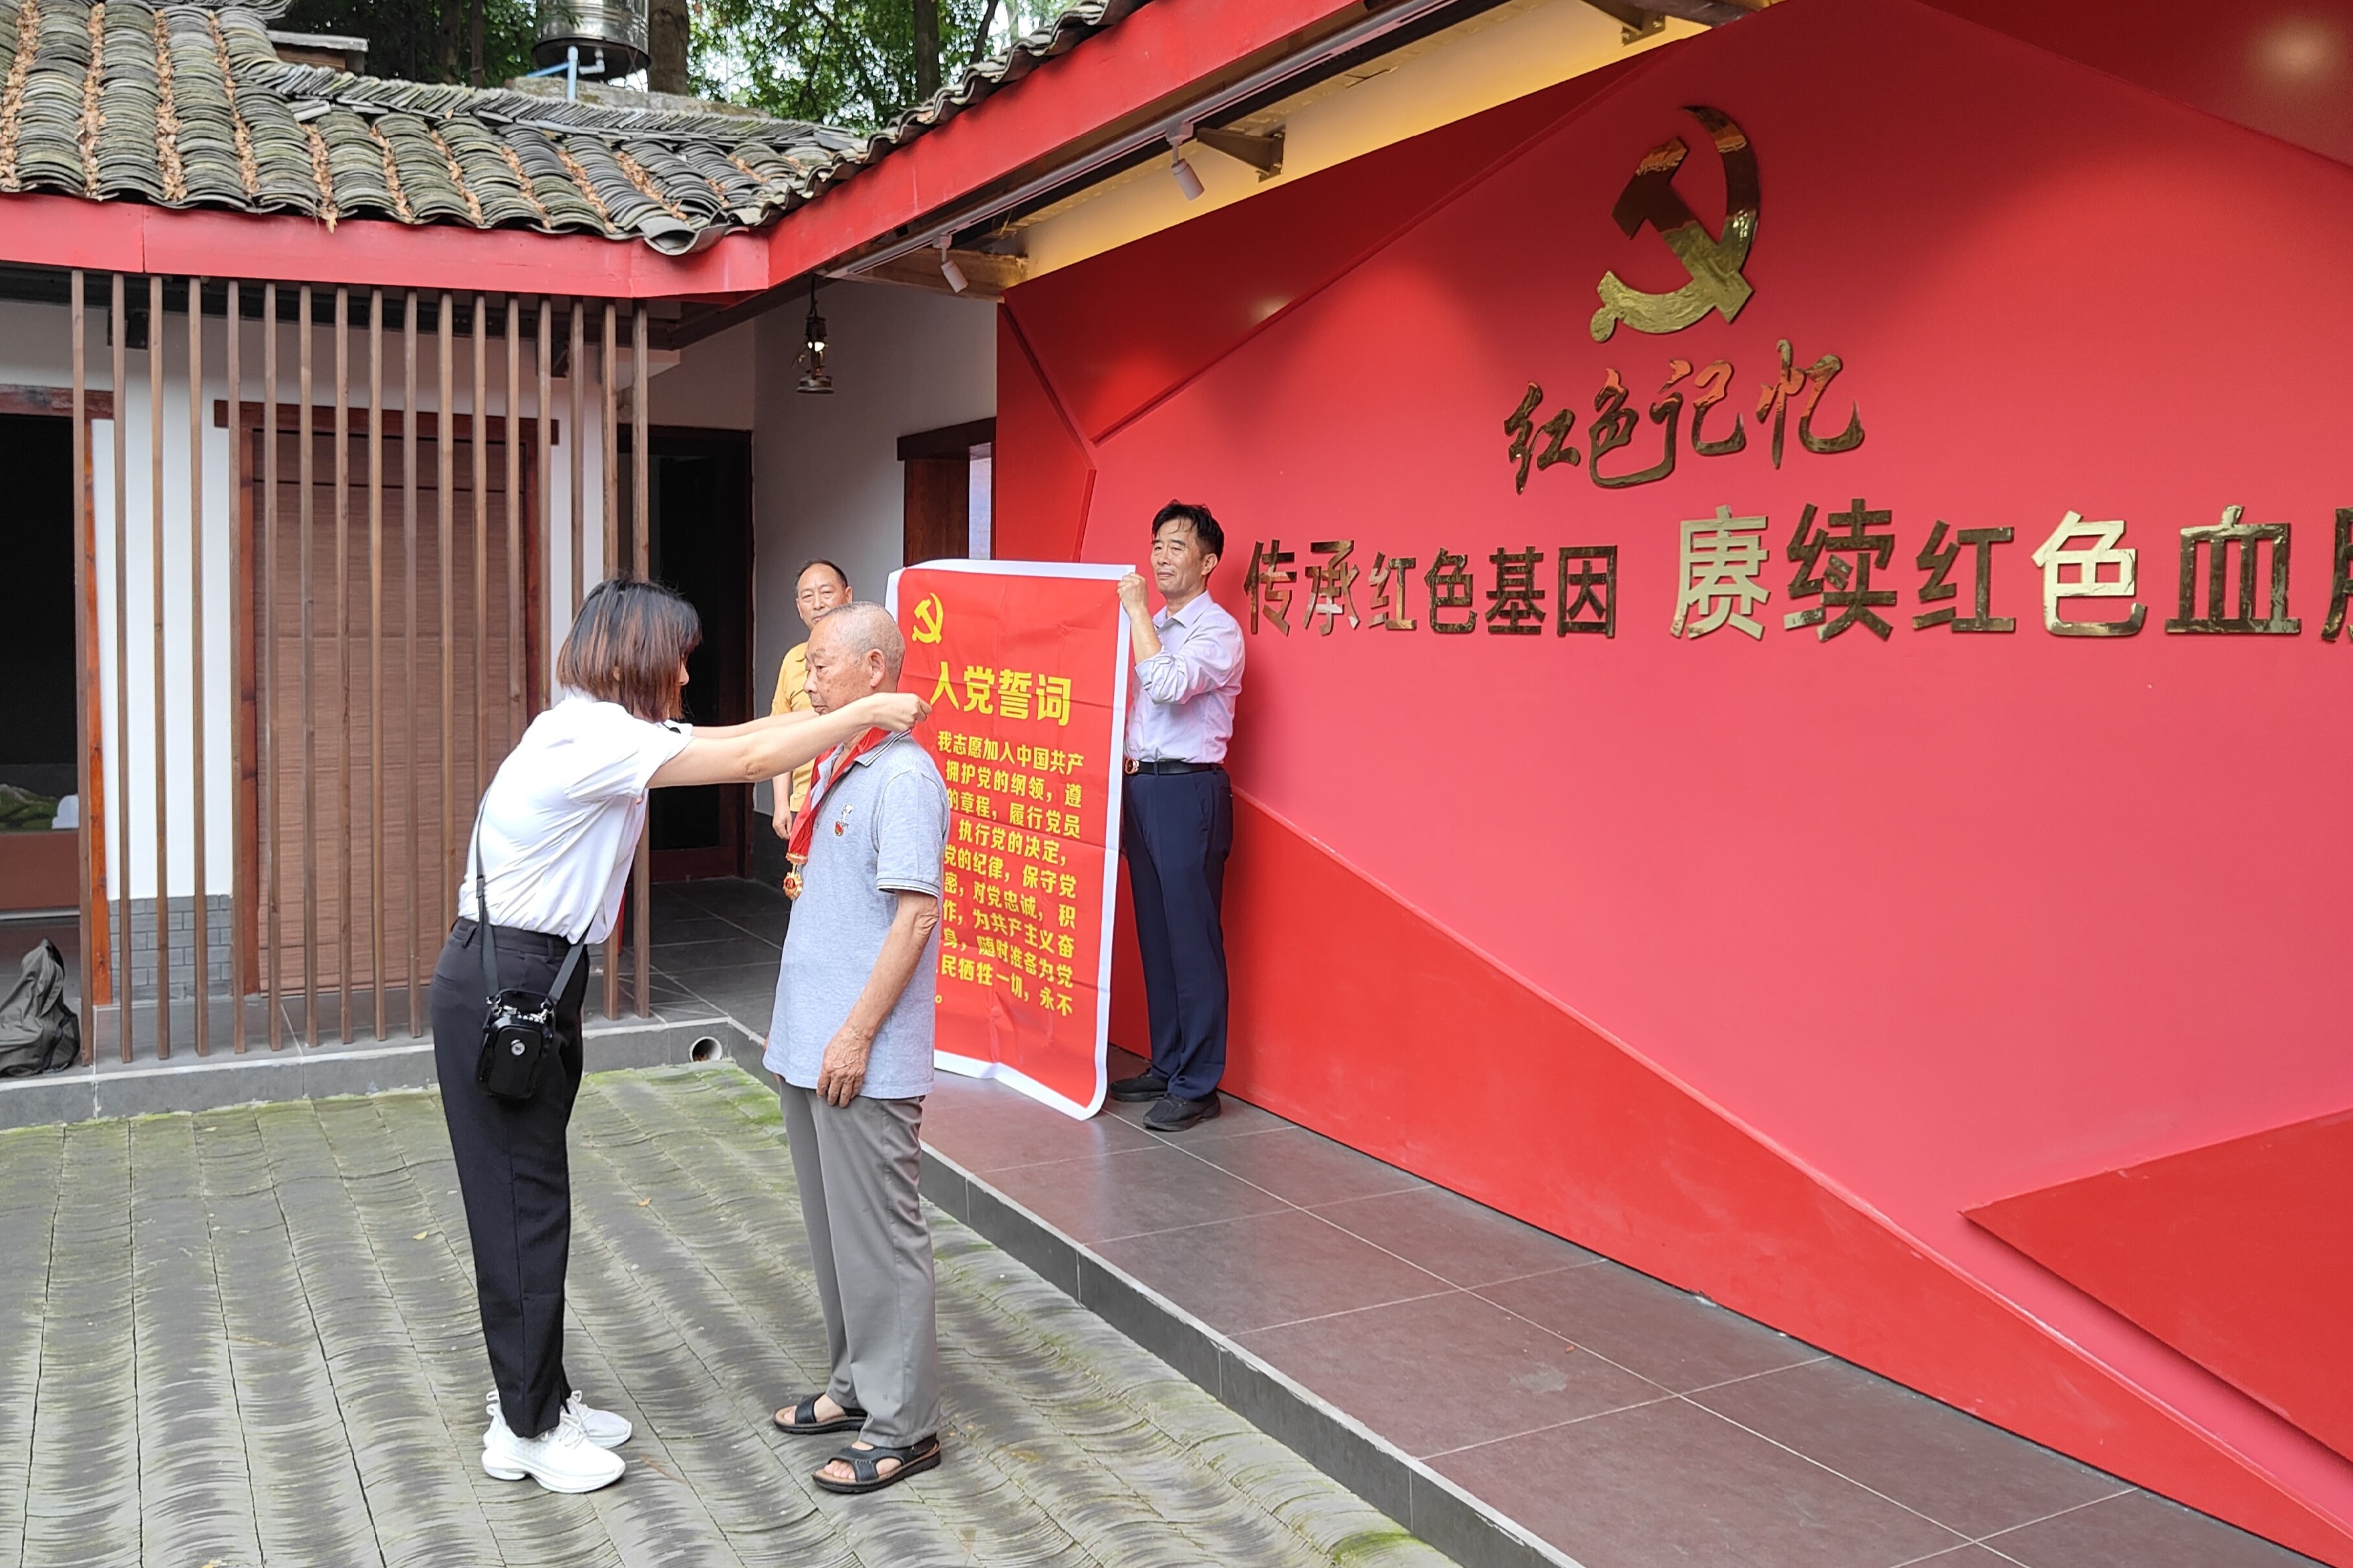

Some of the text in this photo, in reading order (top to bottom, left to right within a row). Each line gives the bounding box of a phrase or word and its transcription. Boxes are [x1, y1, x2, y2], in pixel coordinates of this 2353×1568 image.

[1503, 337, 1865, 494] 红色记忆
[1244, 538, 1618, 638] 传承红色基因
[930, 661, 1071, 726] 入党誓词
[938, 731, 1084, 775] 我志愿加入中国共产
